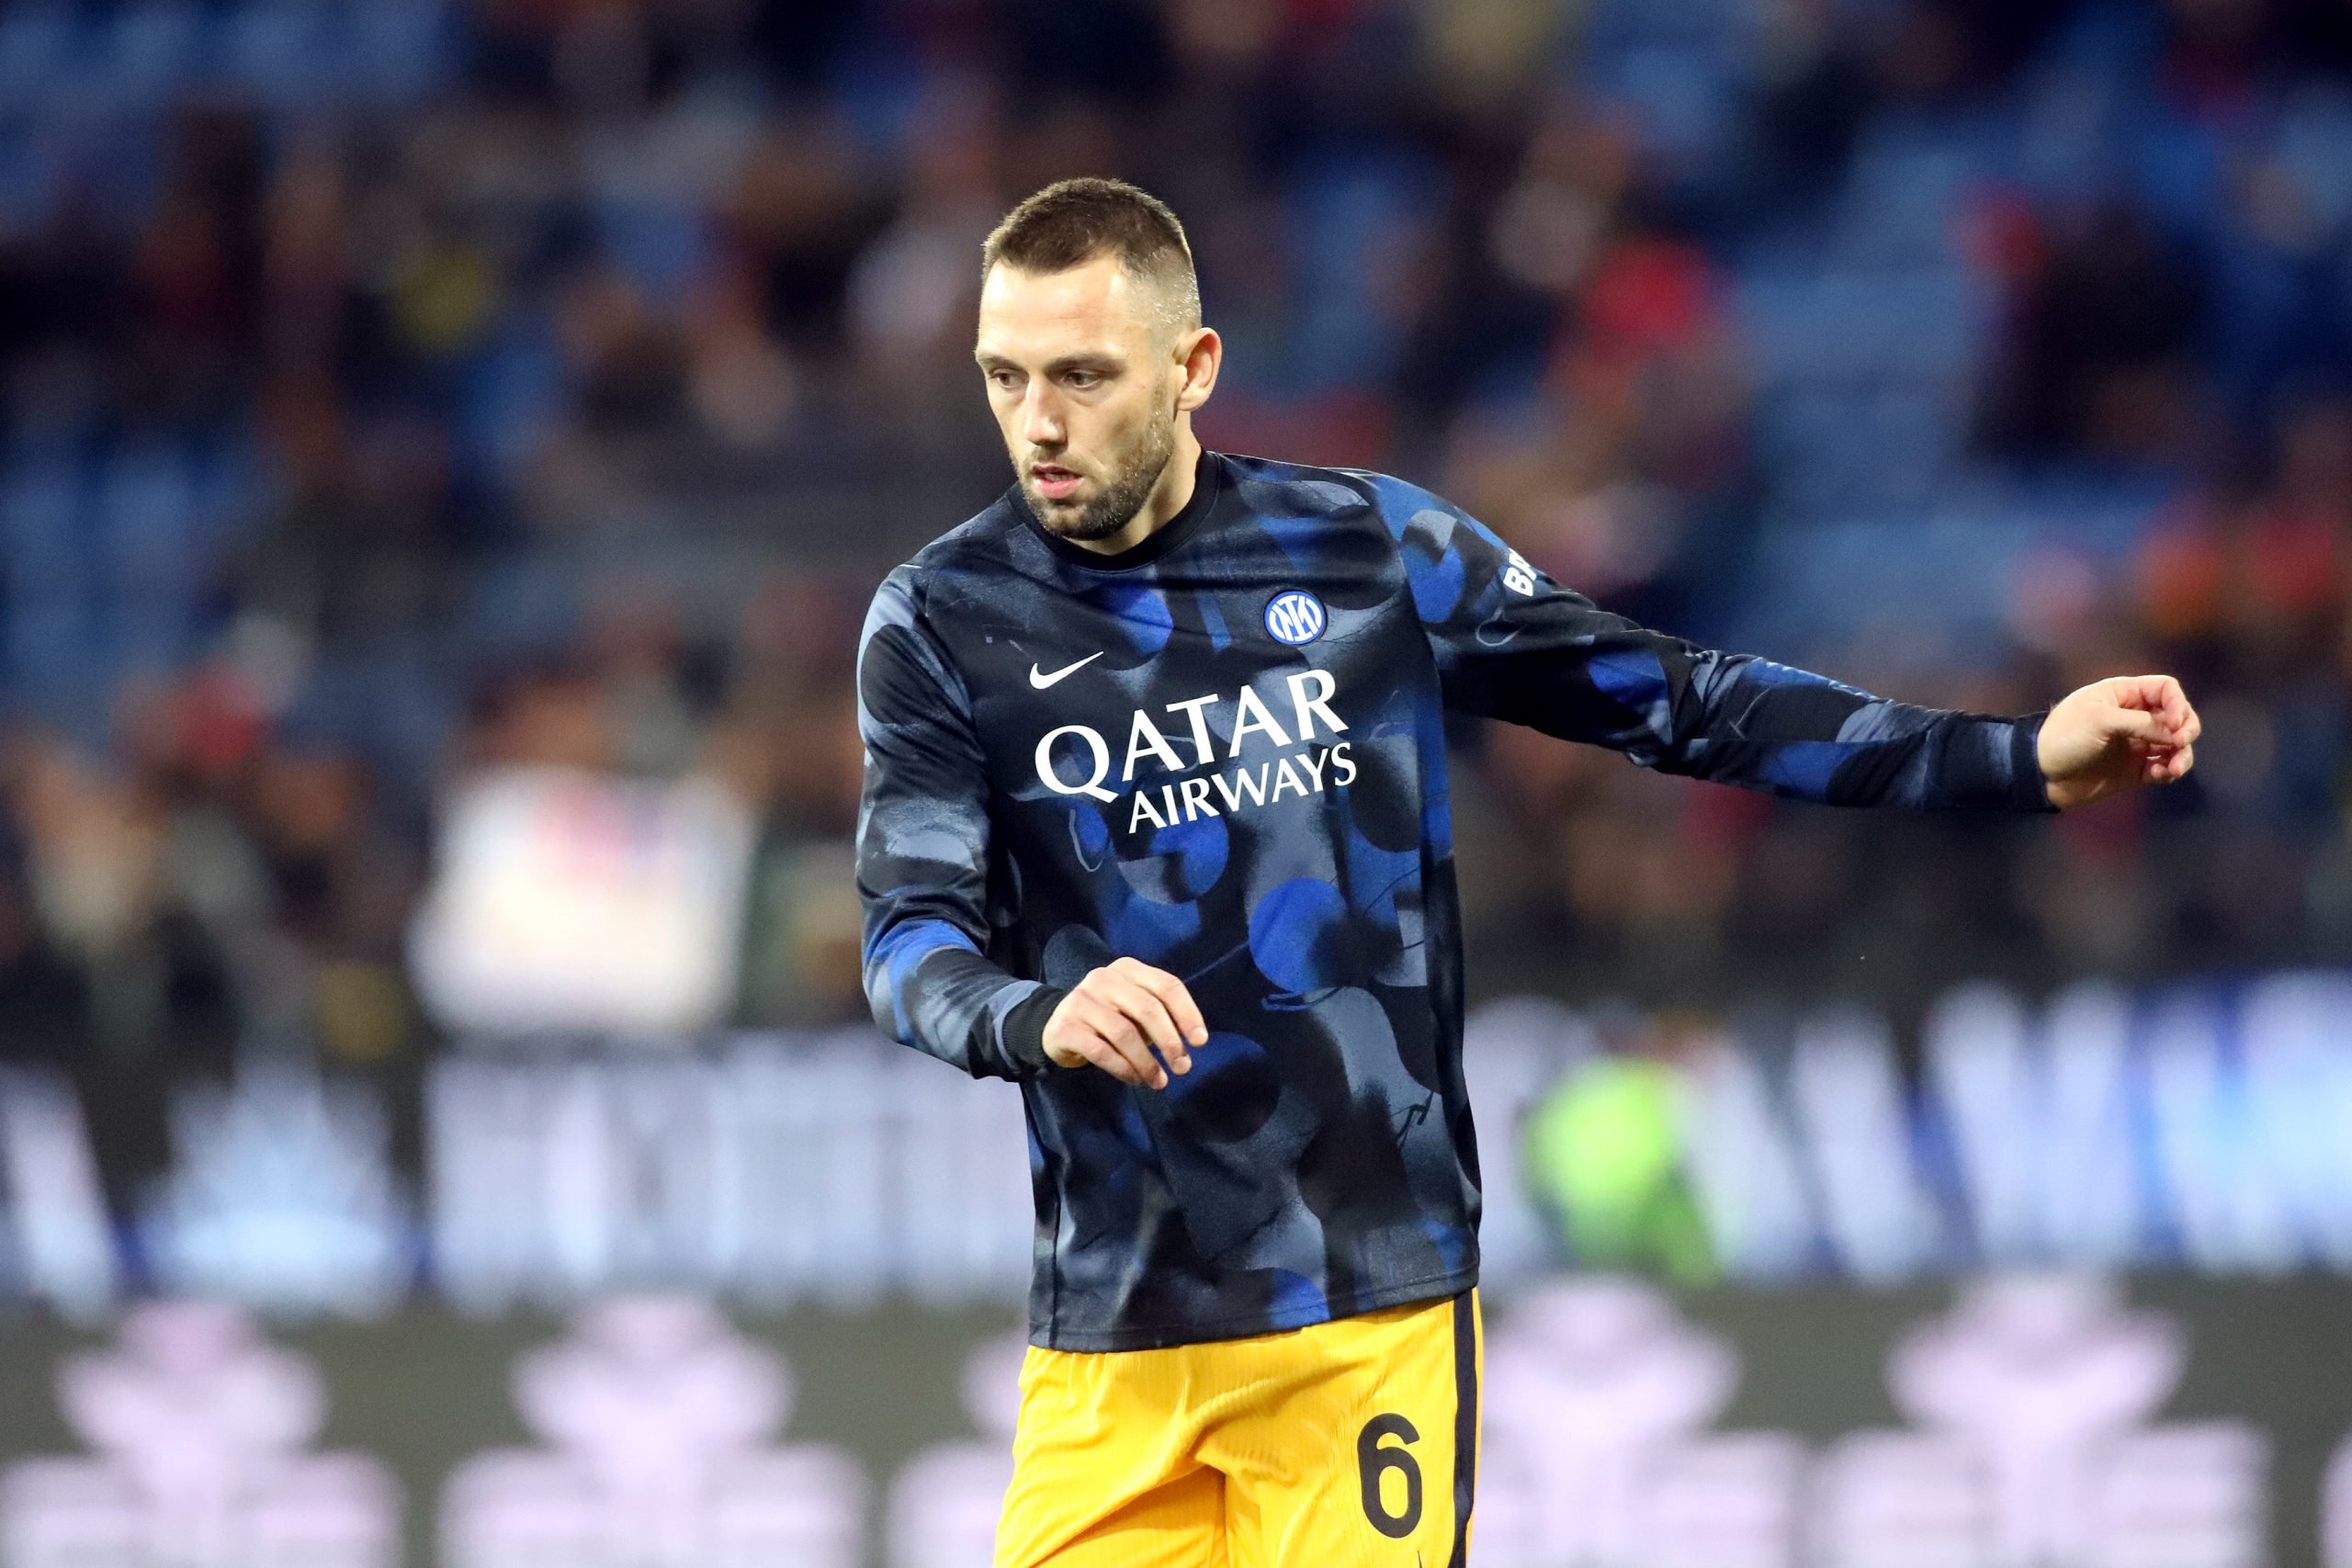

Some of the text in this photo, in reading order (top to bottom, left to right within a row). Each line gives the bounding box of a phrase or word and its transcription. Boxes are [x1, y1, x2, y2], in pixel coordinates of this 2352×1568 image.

[1035, 669, 1350, 803] QATAR
[1128, 742, 1357, 834] AIRWAYS
[1357, 1413, 1422, 1539] 6
